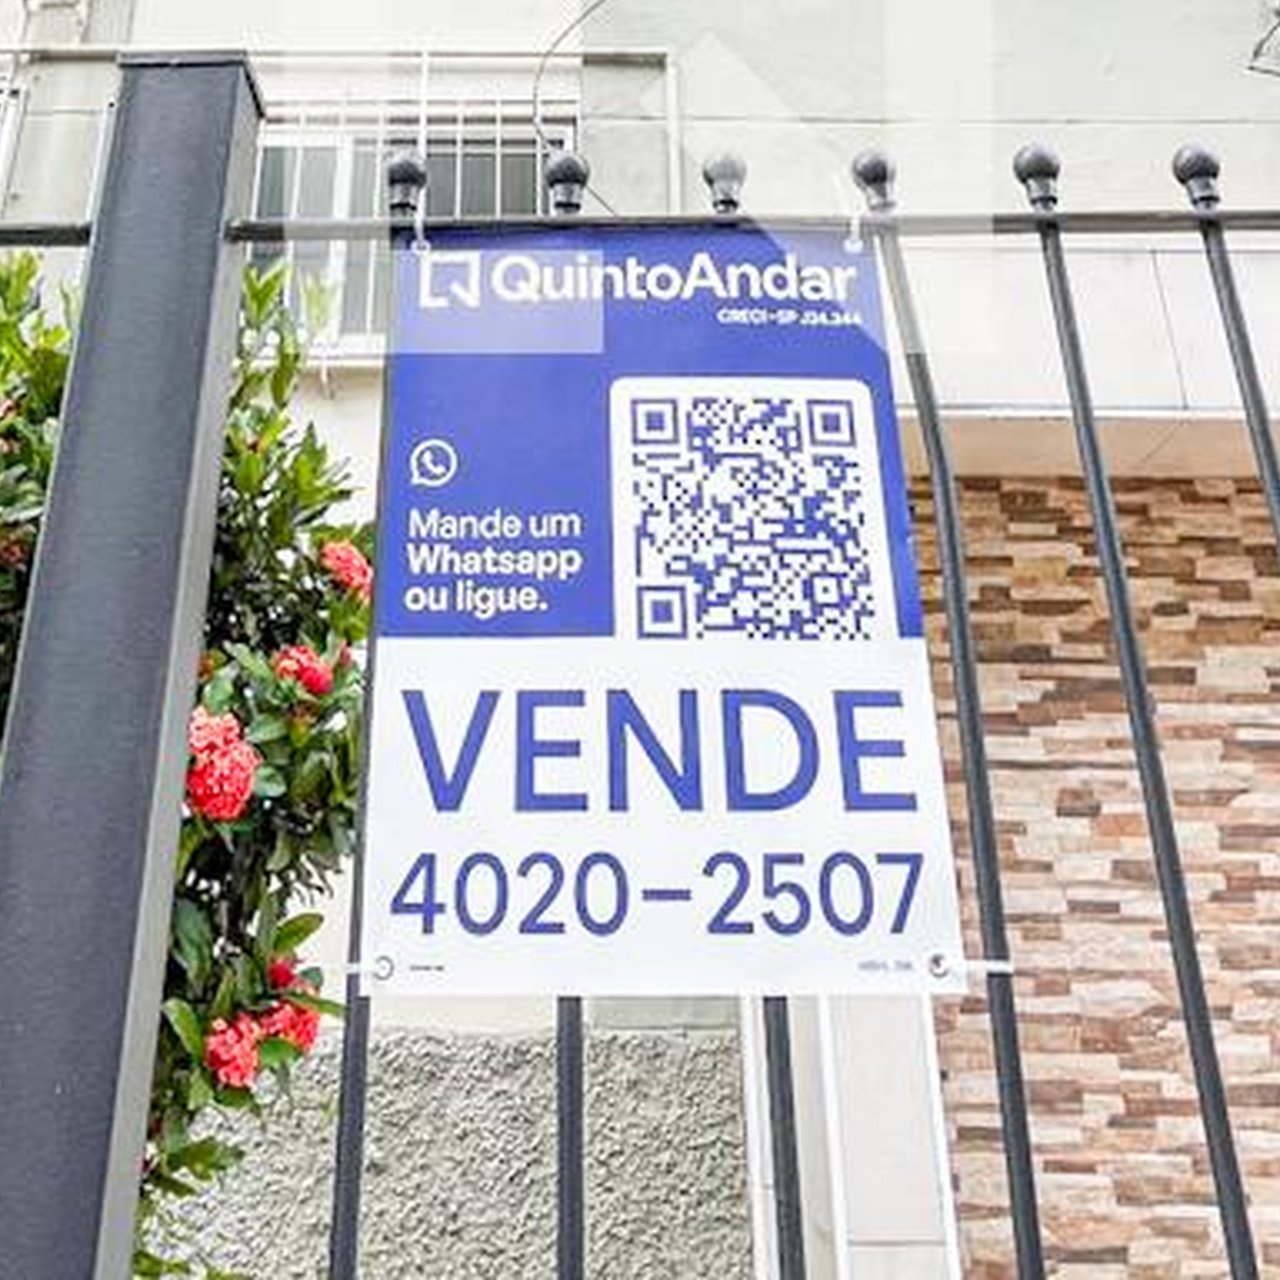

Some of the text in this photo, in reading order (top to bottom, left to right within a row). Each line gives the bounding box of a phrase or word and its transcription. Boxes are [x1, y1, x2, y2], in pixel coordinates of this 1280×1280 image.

[491, 253, 857, 303] QuintoAndar
[408, 507, 582, 539] Mande um
[405, 543, 583, 580] Whatsapp
[404, 579, 549, 620] ou ligue.
[402, 689, 918, 813] VENDE
[388, 850, 925, 937] 4020-2507
